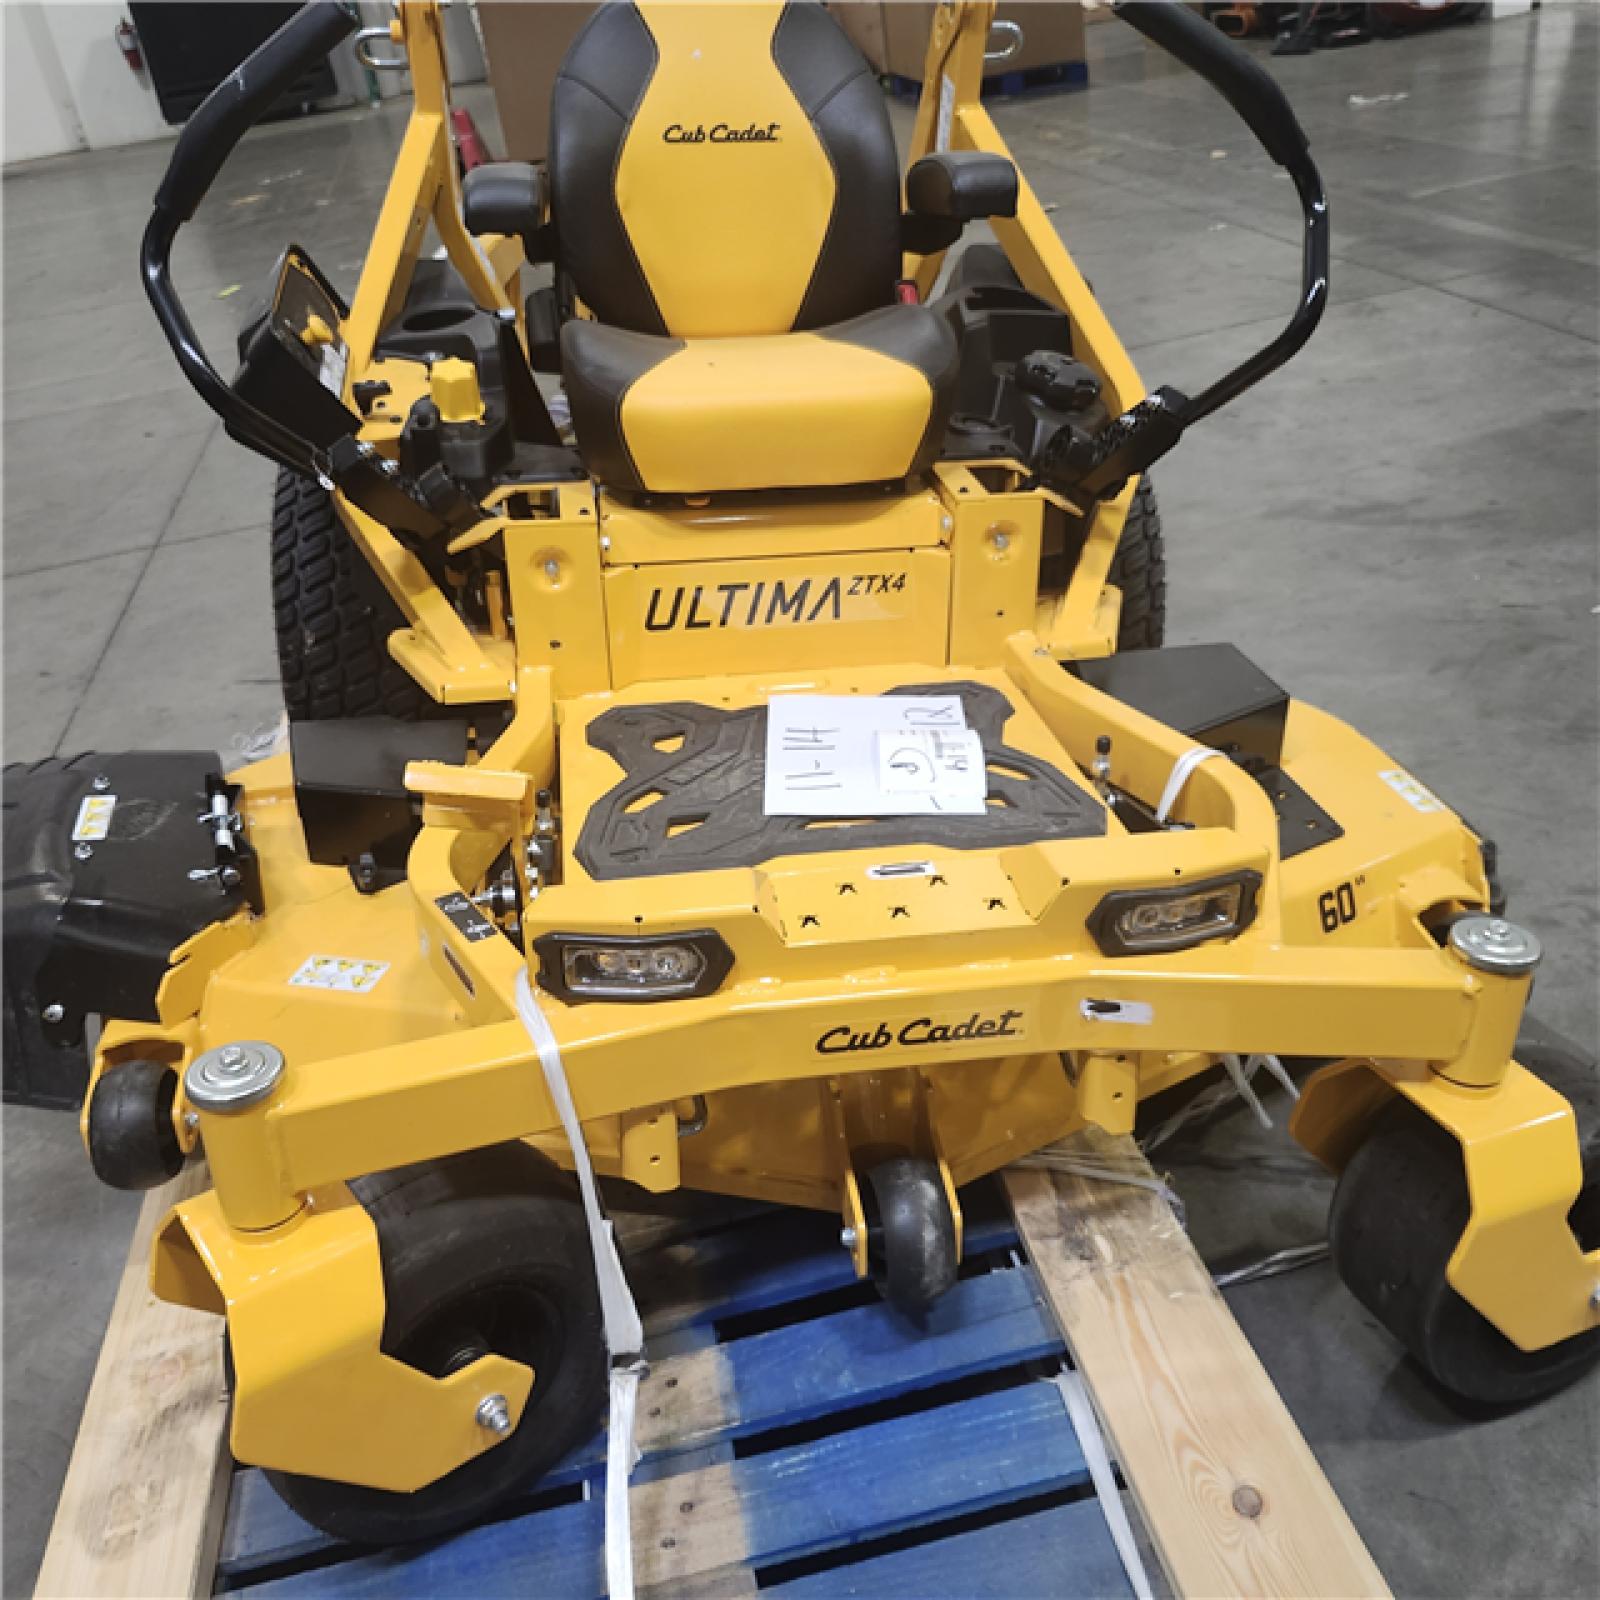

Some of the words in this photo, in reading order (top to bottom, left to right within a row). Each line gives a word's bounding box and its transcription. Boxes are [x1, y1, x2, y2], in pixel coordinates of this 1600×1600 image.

[663, 124, 705, 142] Cub
[710, 122, 780, 142] Cadet
[645, 577, 841, 631] ULTIMA
[847, 571, 907, 595] ZTX4
[815, 1023, 893, 1053] Cub
[897, 1009, 1023, 1046] Cadet
